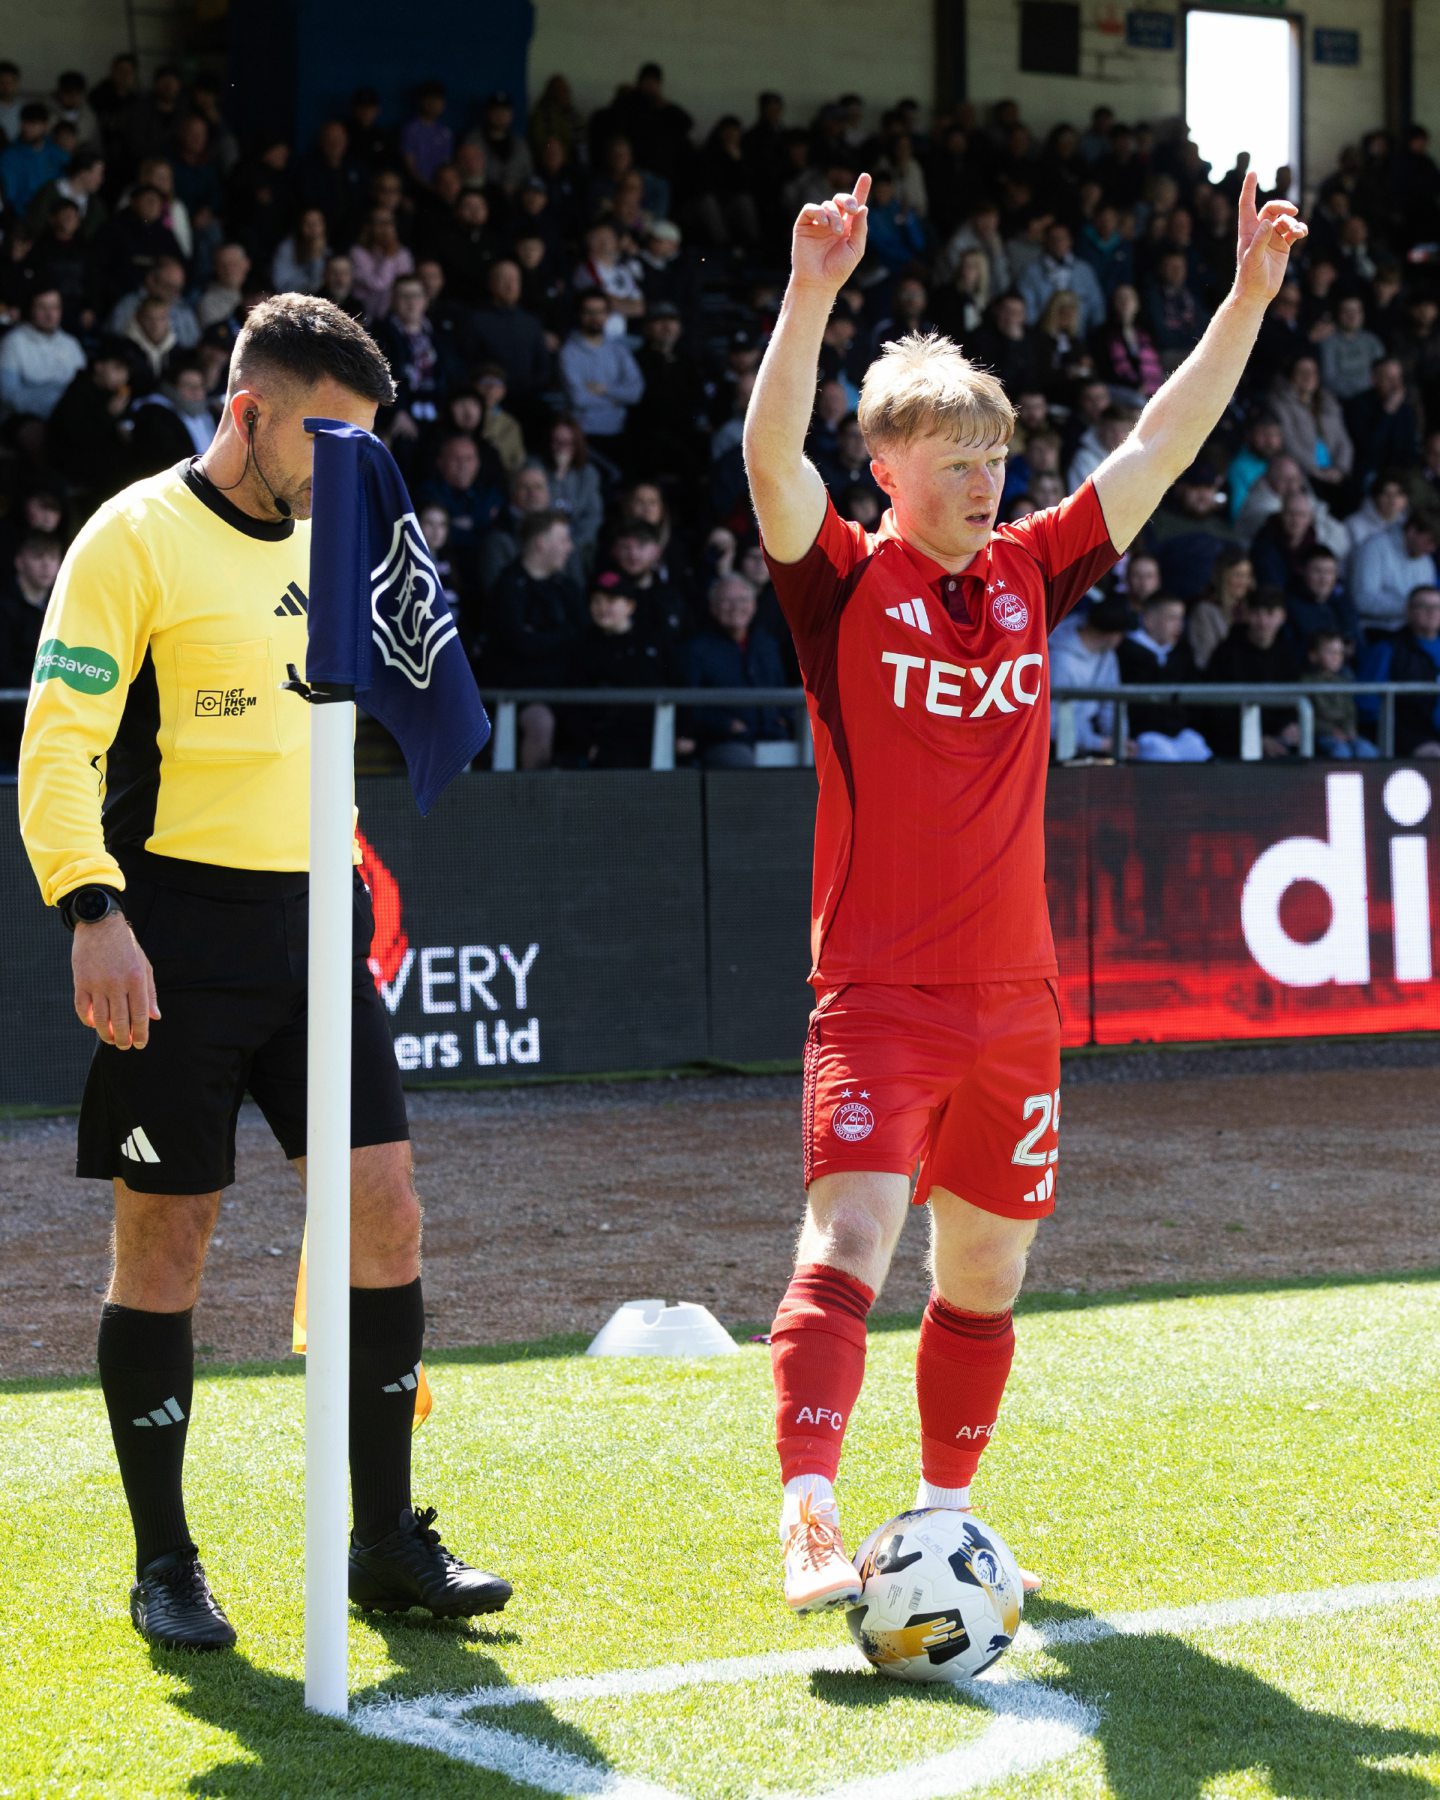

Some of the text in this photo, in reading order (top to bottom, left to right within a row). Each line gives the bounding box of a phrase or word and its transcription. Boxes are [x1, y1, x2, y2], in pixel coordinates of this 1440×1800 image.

[881, 651, 1043, 718] TEXO
[225, 688, 245, 698] LET
[225, 697, 257, 707] THEM
[223, 707, 246, 716] REF
[475, 1017, 540, 1065] Ltd
[840, 1104, 869, 1115] ABERDEEN
[835, 1124, 861, 1139] FOOTBALL
[860, 1124, 872, 1137] CLUB
[796, 1406, 843, 1431] AFC
